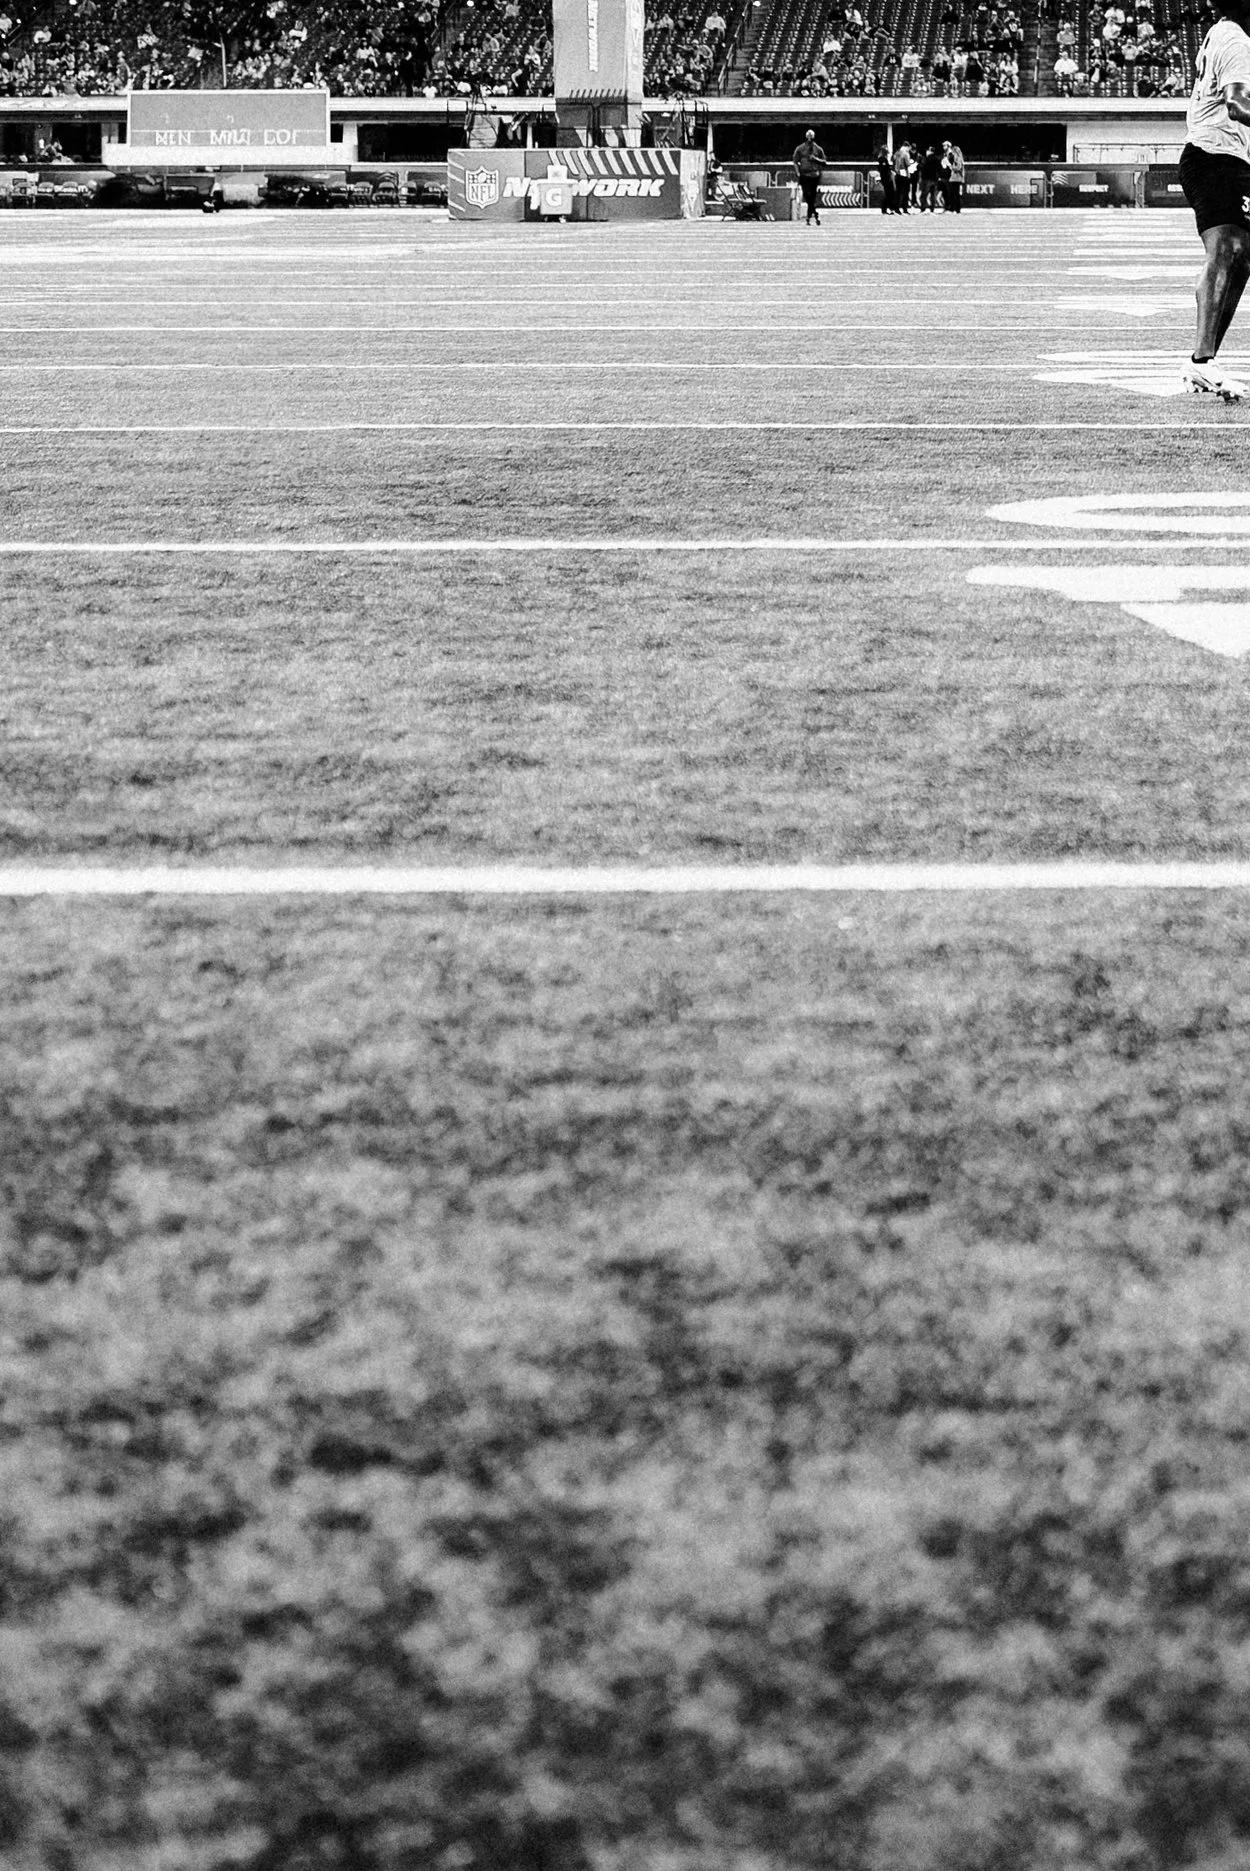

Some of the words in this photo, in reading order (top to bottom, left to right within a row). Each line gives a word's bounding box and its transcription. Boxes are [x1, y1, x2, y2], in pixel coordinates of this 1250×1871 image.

[470, 184, 496, 199] NFL
[546, 188, 563, 206] G
[966, 184, 995, 195] NEXT
[1010, 184, 1038, 195] HERE
